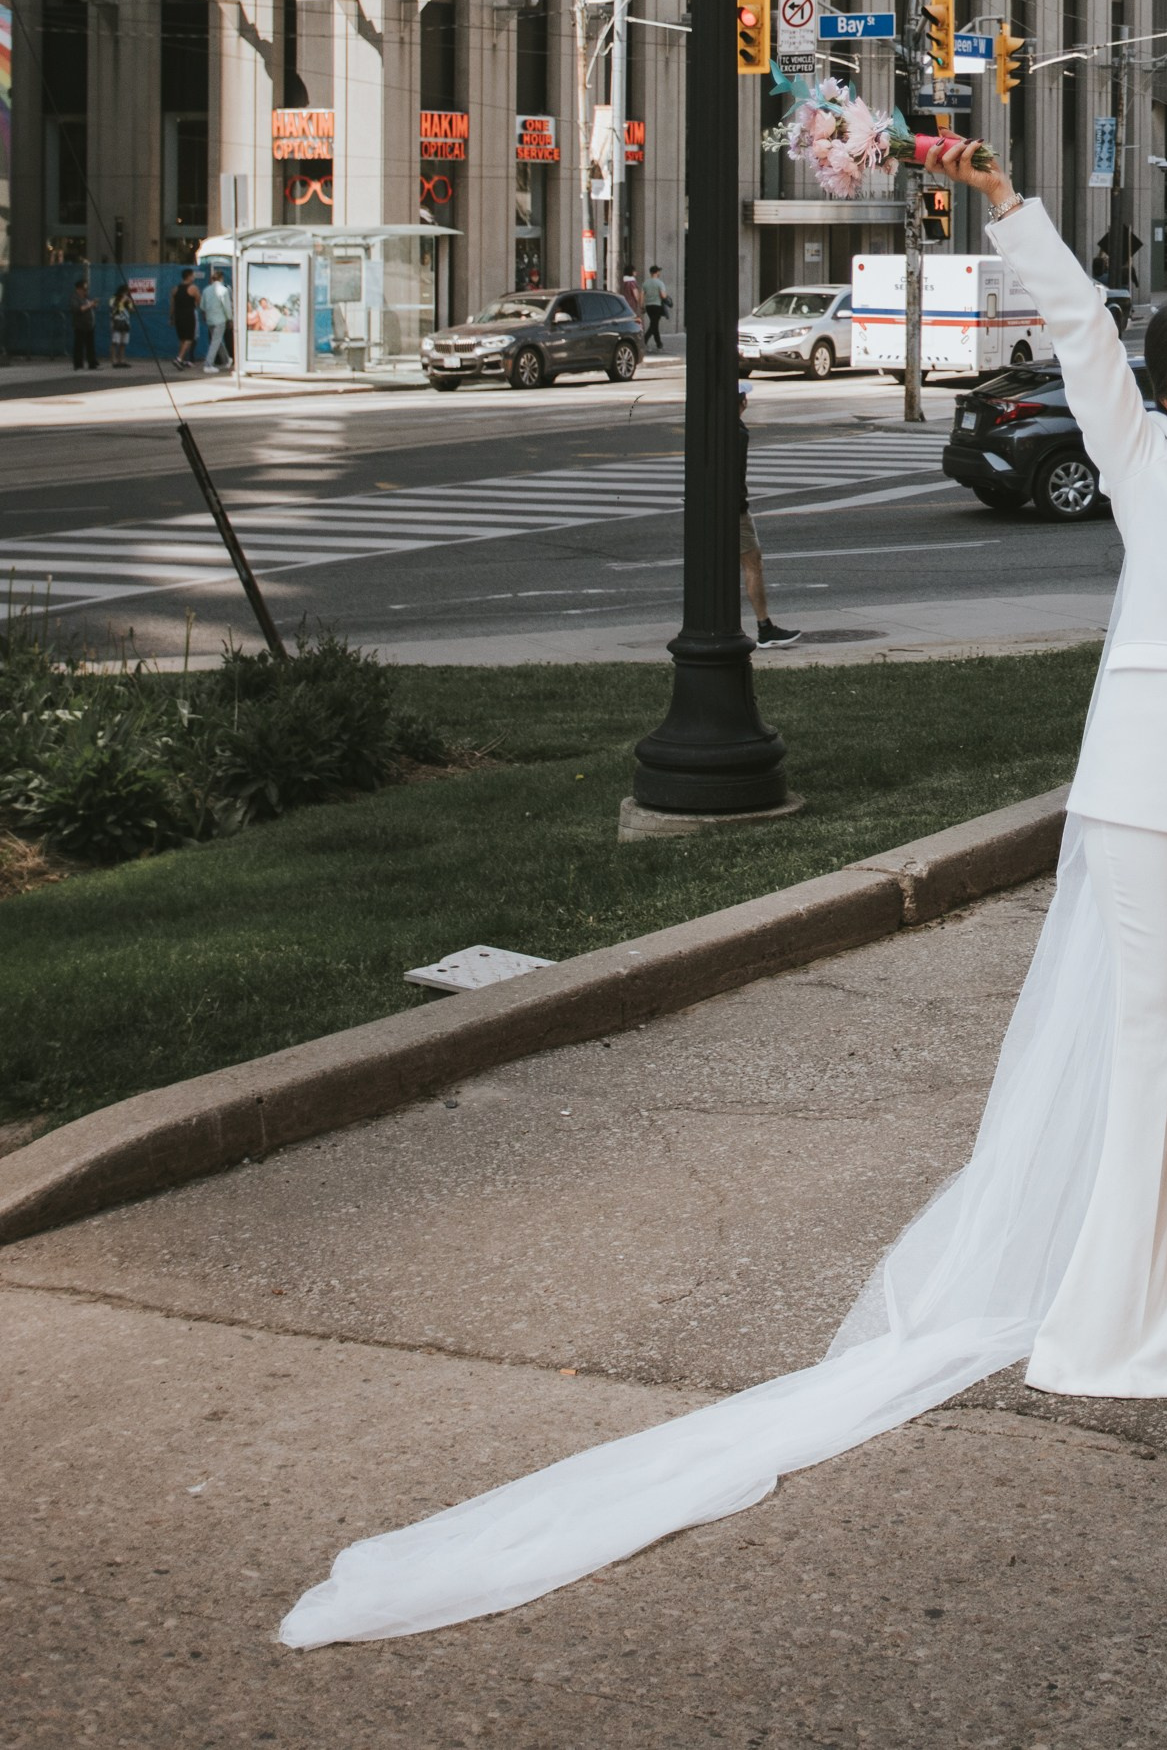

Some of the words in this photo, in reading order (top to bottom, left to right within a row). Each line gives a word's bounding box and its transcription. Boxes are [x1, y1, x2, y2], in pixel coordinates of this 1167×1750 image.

[837, 16, 865, 37] Bay
[866, 16, 876, 26] St
[979, 39, 986, 54] W
[780, 64, 813, 73] EXCEPTED
[272, 109, 335, 138] HAKIM
[421, 112, 469, 139] HAKIM
[524, 119, 550, 132] ONE
[522, 134, 553, 146] HOUR
[273, 137, 333, 161] OPTICAL
[421, 141, 466, 159] OPTICAL
[516, 147, 561, 161] SERVICE
[624, 150, 644, 161] SIVE
